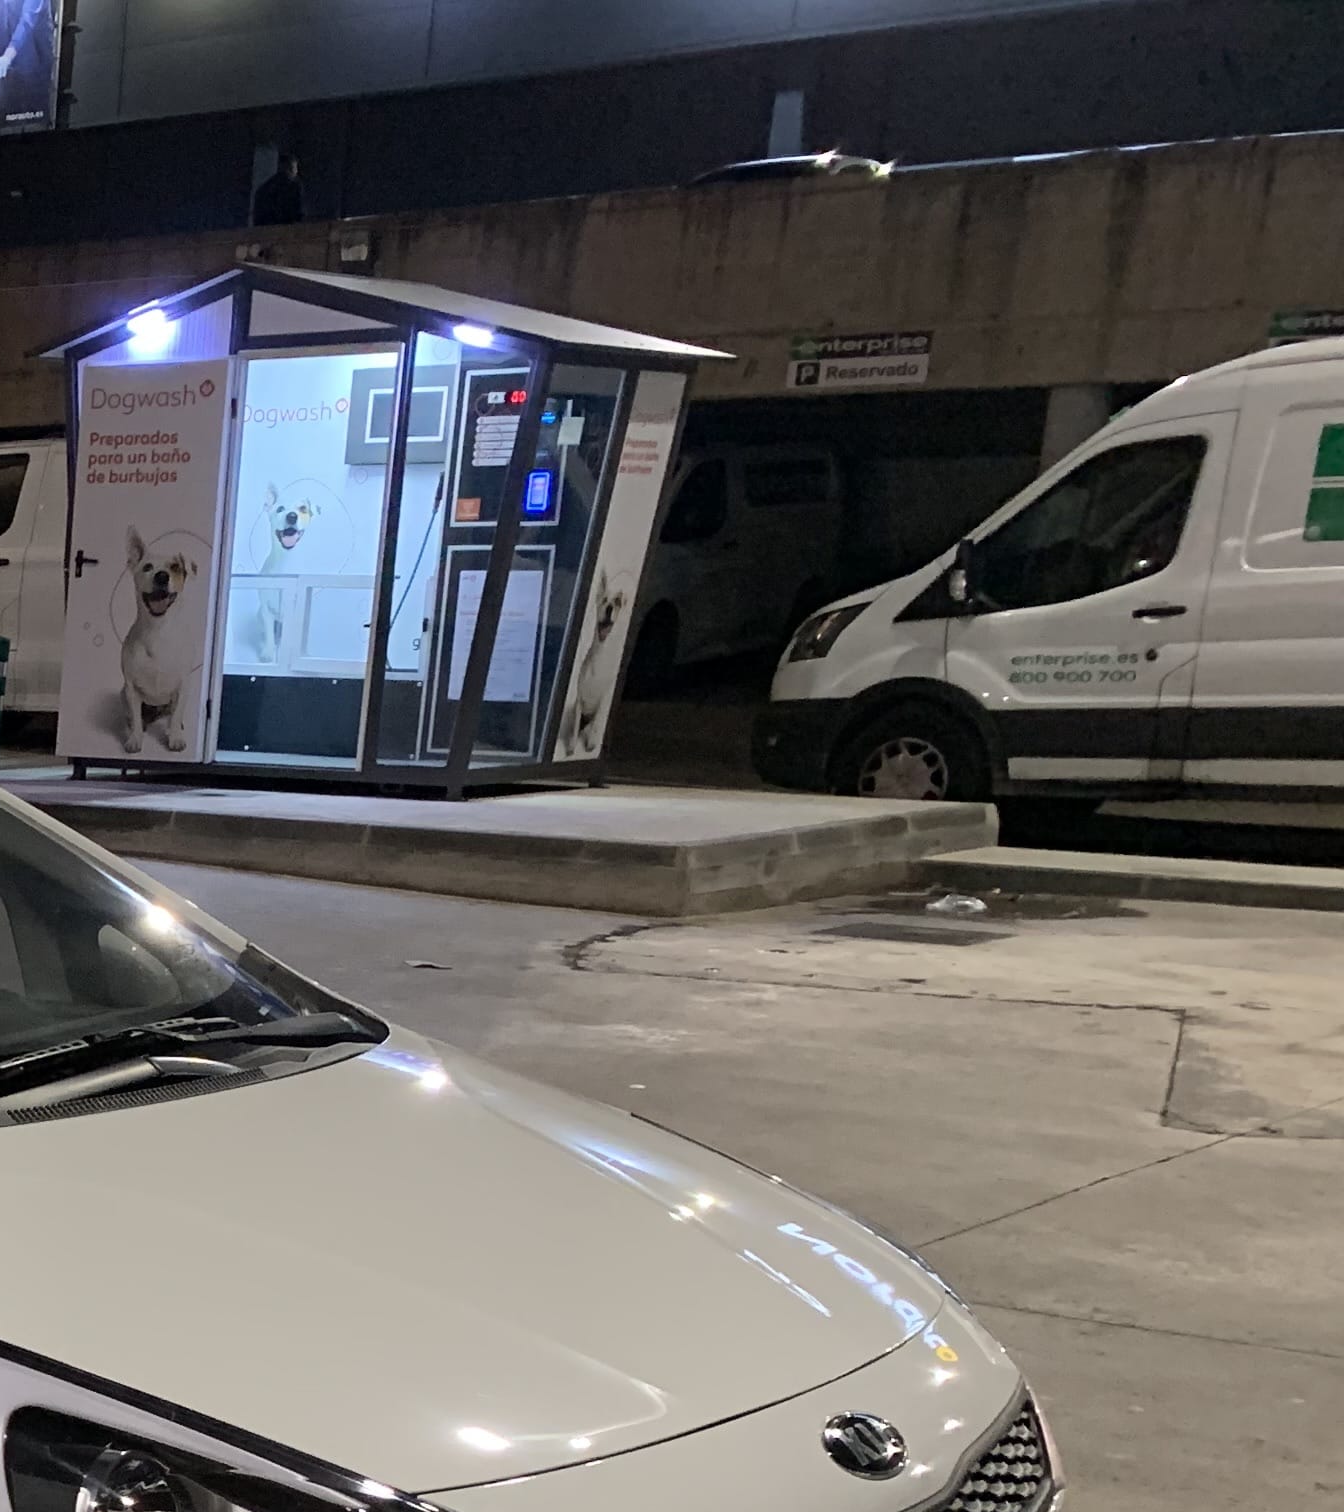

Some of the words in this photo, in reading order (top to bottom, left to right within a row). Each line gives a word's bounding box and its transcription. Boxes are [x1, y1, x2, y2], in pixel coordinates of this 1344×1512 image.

[794, 335, 928, 353] enterprise
[825, 362, 919, 380] Reservado
[90, 384, 196, 415] Dogwash
[243, 401, 332, 428] Dogwash
[89, 430, 179, 449] Preparados
[88, 453, 124, 469] para
[128, 453, 147, 464] un
[151, 448, 191, 464] baño
[86, 469, 105, 484] de
[109, 468, 177, 486] burbujas
[1053, 669, 1092, 683] 900
[1098, 669, 1137, 682] 700
